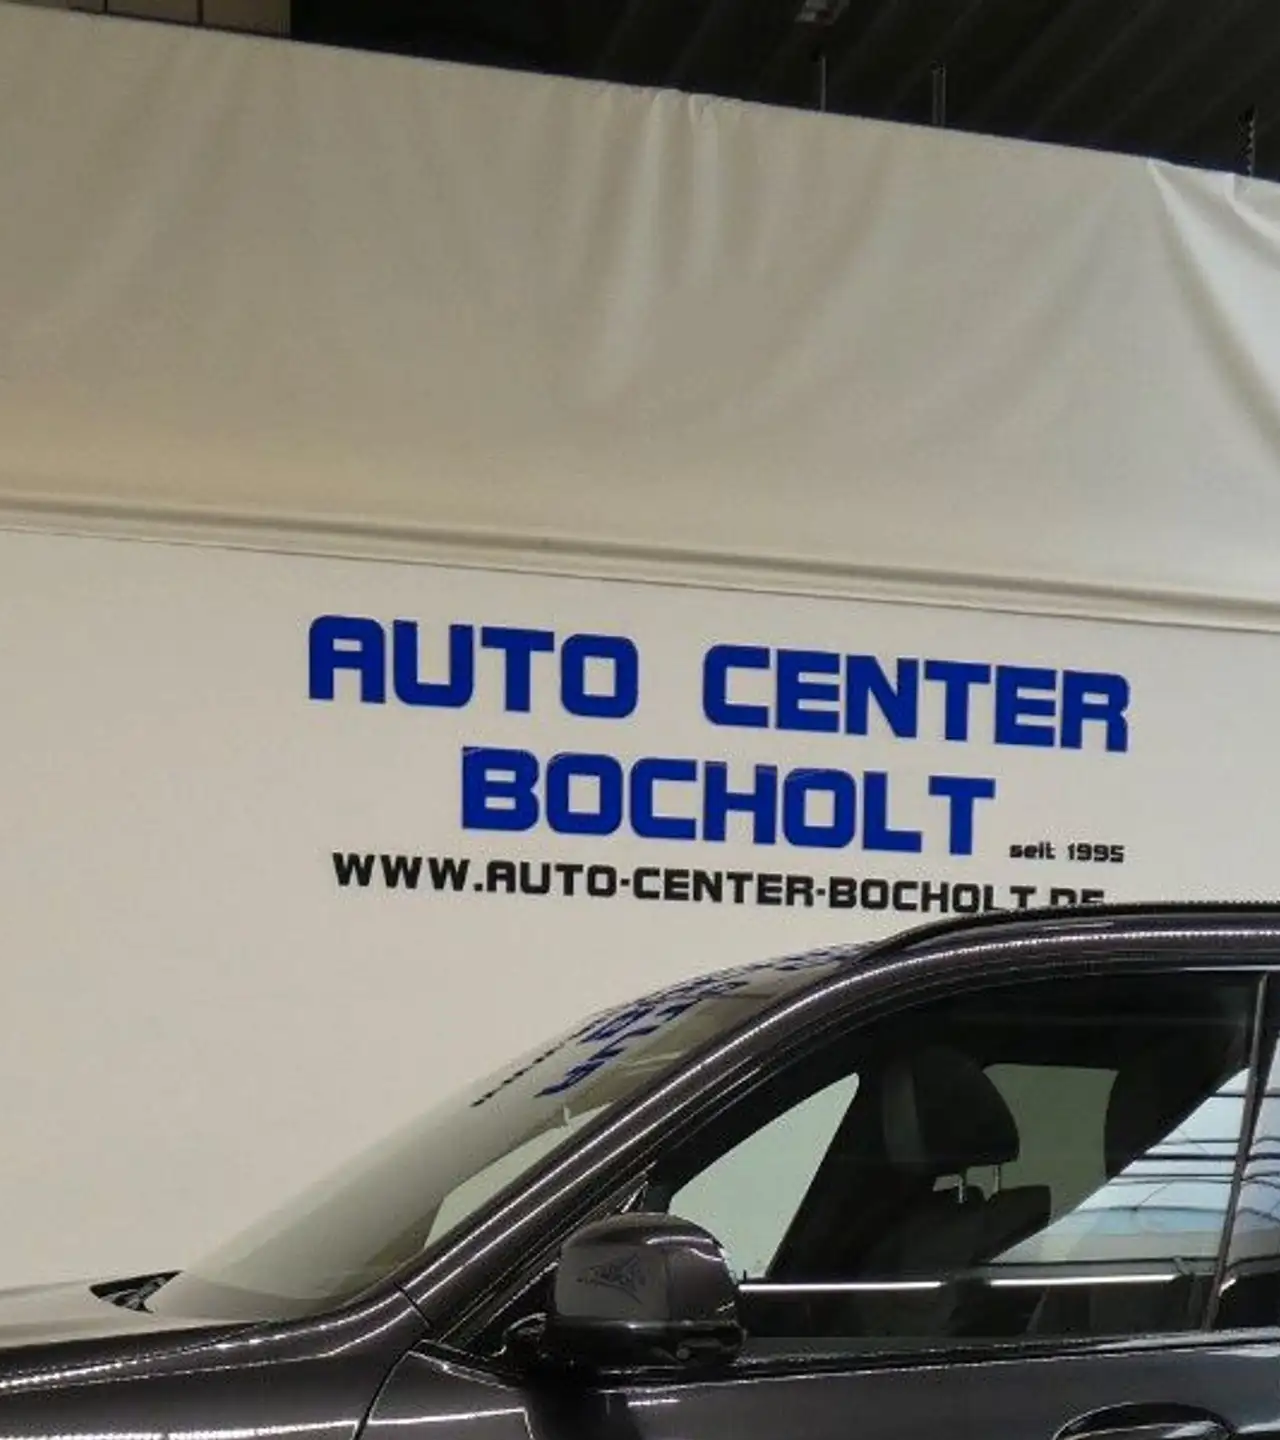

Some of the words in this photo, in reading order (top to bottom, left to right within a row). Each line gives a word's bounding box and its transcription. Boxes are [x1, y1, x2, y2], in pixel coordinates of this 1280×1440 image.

[308, 615, 639, 719] AUTO
[702, 644, 1131, 753] CENTER
[461, 746, 998, 857] BOCHOLT
[1009, 841, 1056, 860] seit
[1067, 843, 1124, 863] 1995
